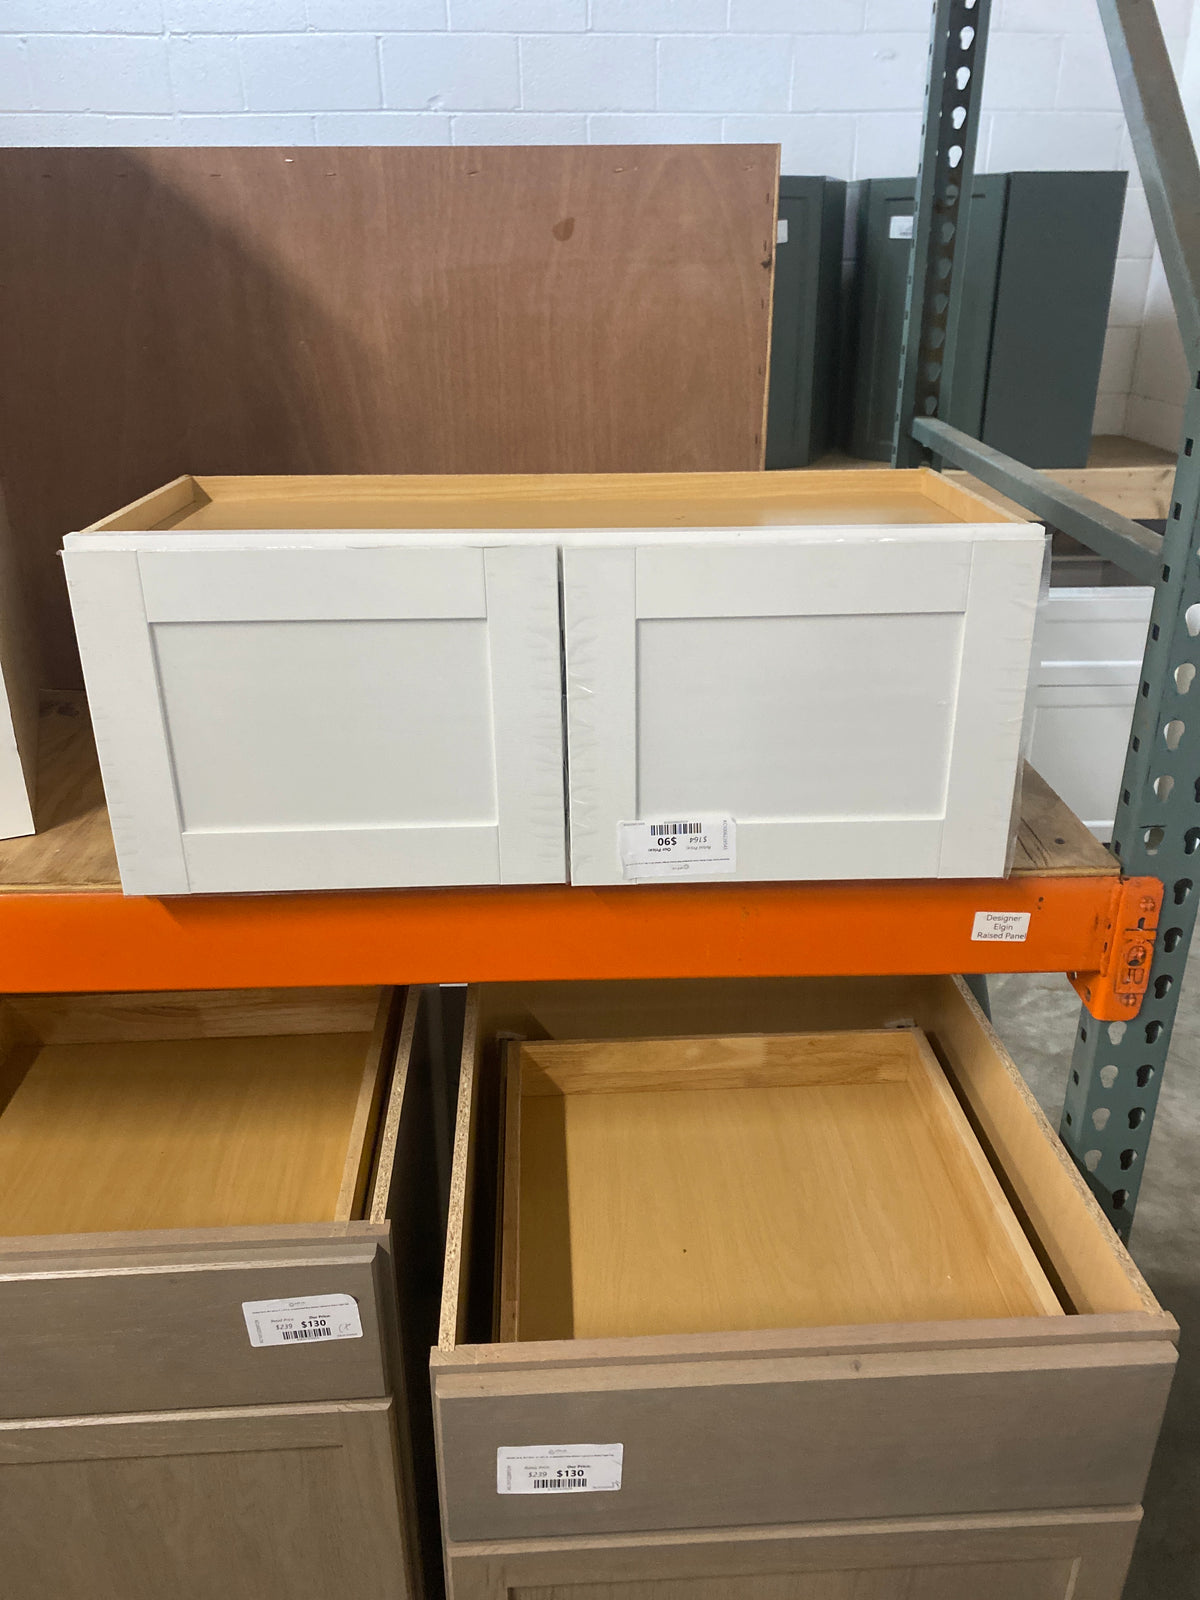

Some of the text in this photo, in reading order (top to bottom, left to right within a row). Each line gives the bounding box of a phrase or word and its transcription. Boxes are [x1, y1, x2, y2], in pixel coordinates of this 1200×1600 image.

[657, 836, 677, 847] $90
[986, 914, 1023, 923] Designer
[993, 923, 1014, 932] Elgin
[976, 931, 1004, 939] Raised
[275, 1319, 327, 1331] $239 $130
[556, 1469, 585, 1478] $130
